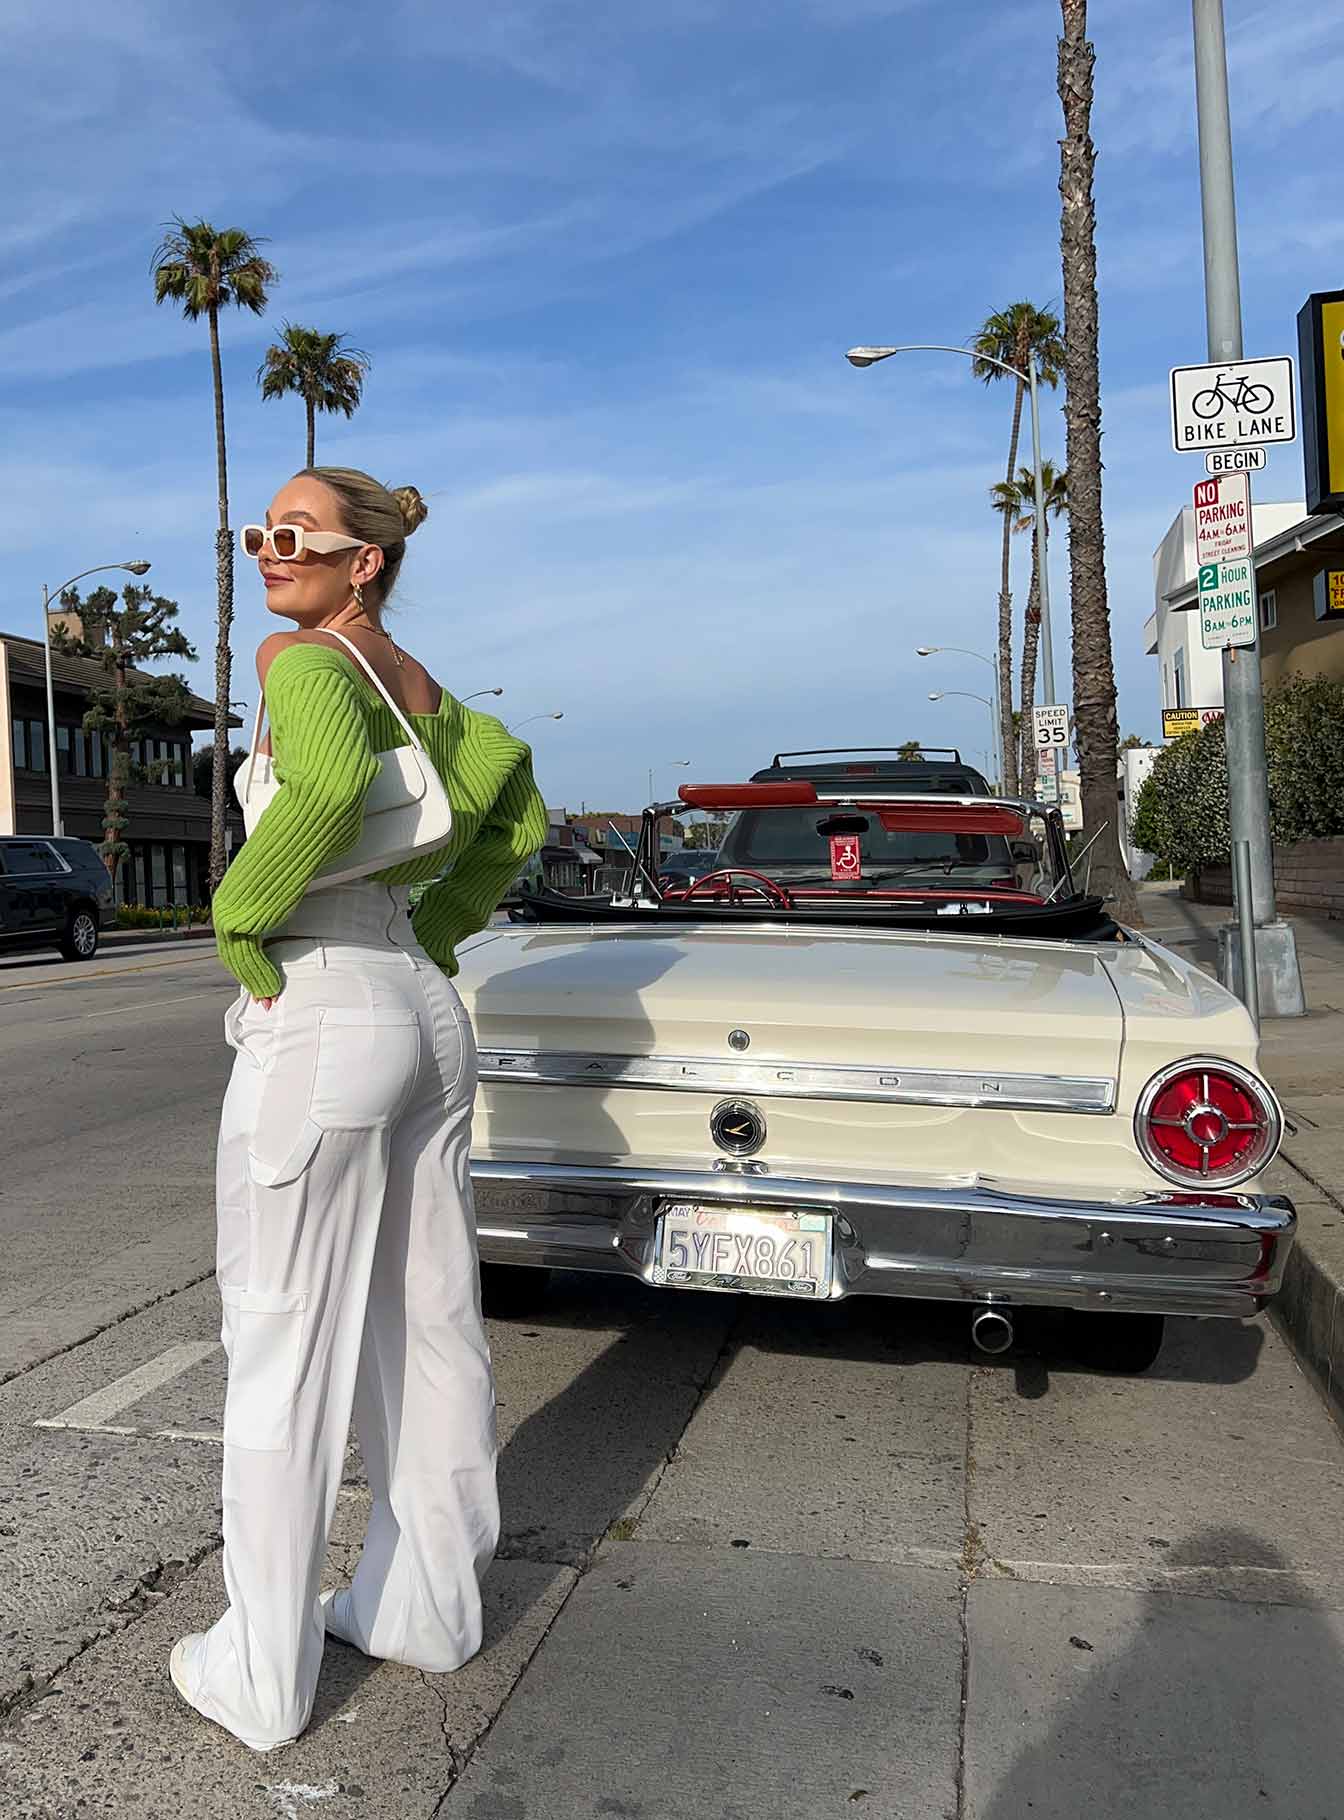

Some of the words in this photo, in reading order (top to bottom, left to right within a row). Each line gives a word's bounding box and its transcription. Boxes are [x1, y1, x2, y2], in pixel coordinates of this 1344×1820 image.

[1185, 422, 1226, 441] BIKE
[1238, 416, 1285, 437] LANE
[1213, 451, 1259, 470] BEGIN
[1197, 483, 1215, 504] NO
[1199, 501, 1244, 525] PARKING
[1202, 568, 1215, 588] 2
[1221, 566, 1247, 584] HOUR
[1203, 590, 1251, 612] PARKING
[1035, 709, 1066, 719] SPEED
[1039, 718, 1062, 727] LIMIT
[1165, 711, 1198, 720] CAUTION
[1038, 727, 1066, 744] 35
[669, 1230, 818, 1280] 5YFX861
